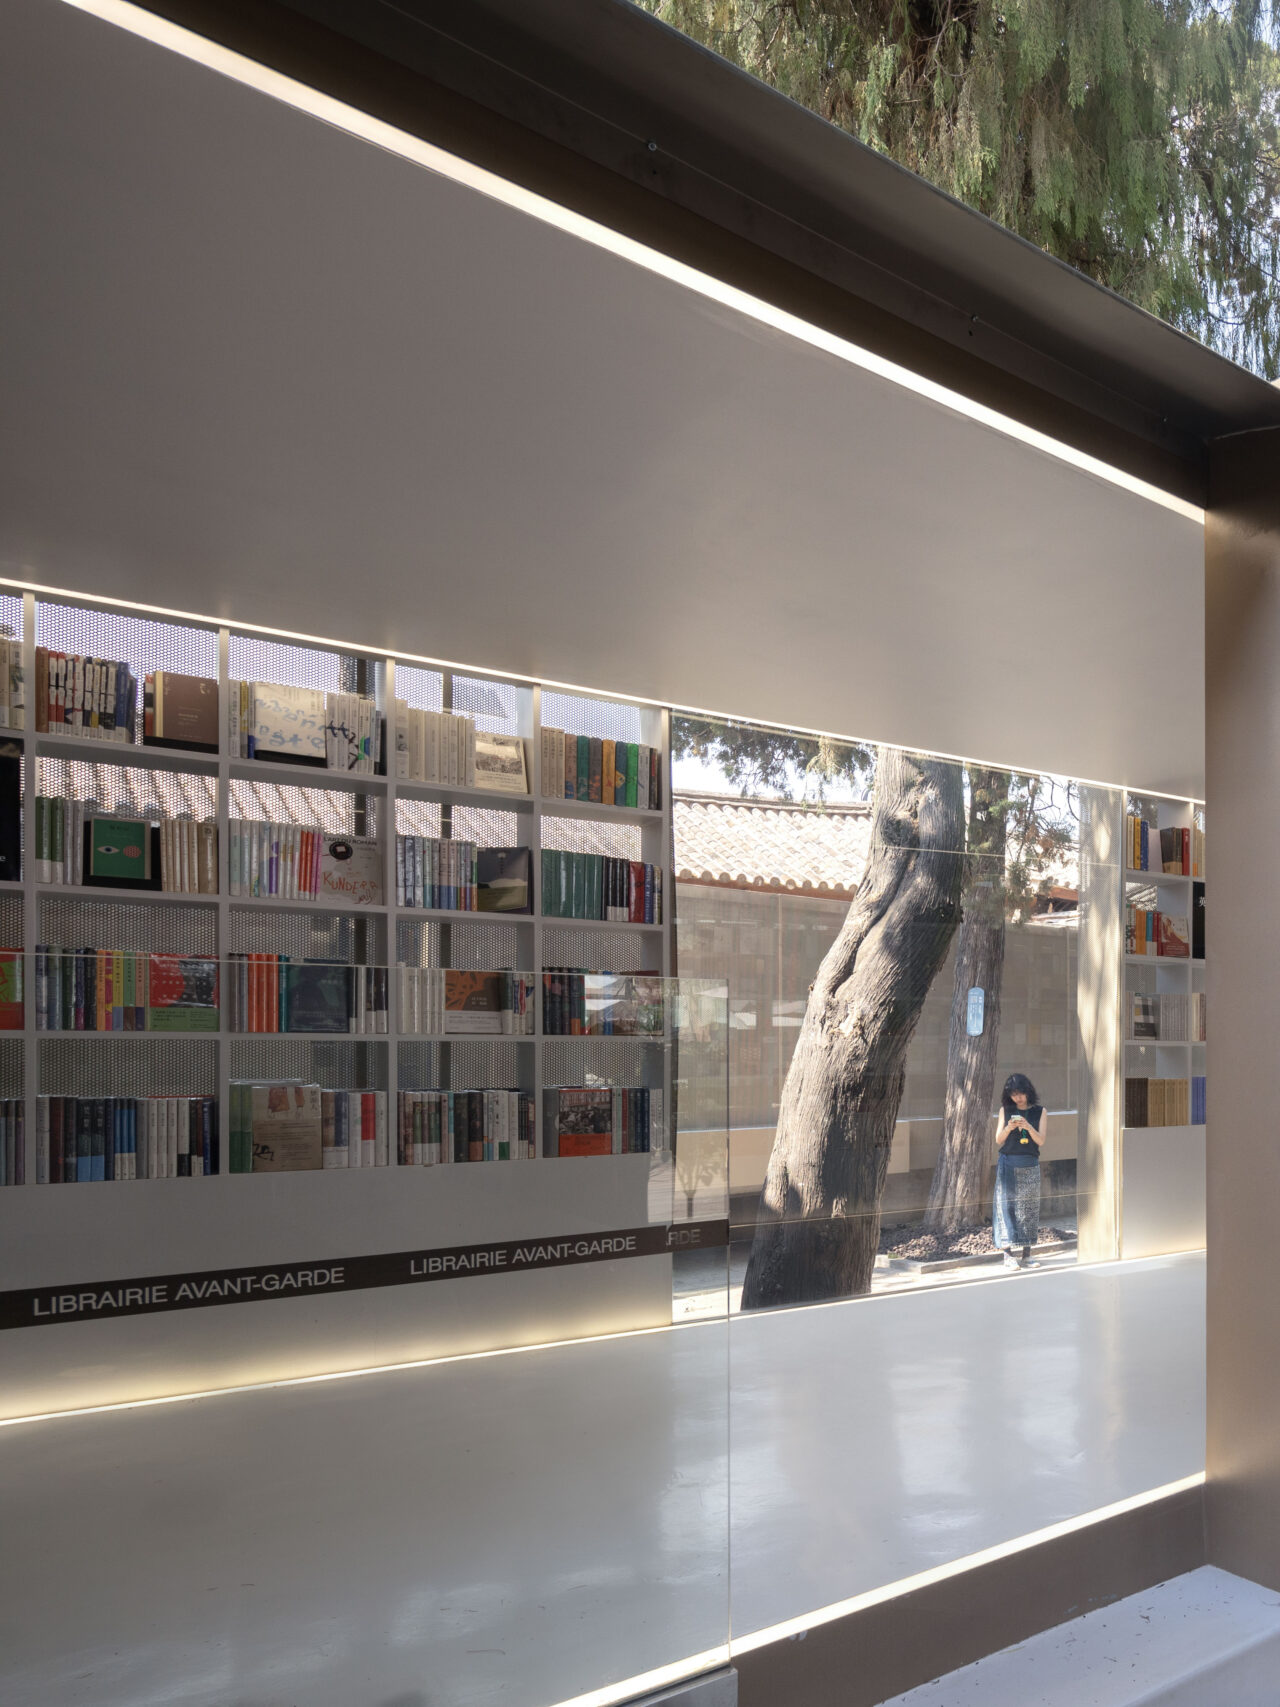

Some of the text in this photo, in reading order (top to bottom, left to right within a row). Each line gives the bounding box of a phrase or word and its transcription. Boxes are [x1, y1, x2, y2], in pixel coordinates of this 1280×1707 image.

[410, 1236, 636, 1276] LIBRAIRIE AVANT-GARDE
[33, 1267, 345, 1317] LIBRAIRIE AVANT-GARDE
